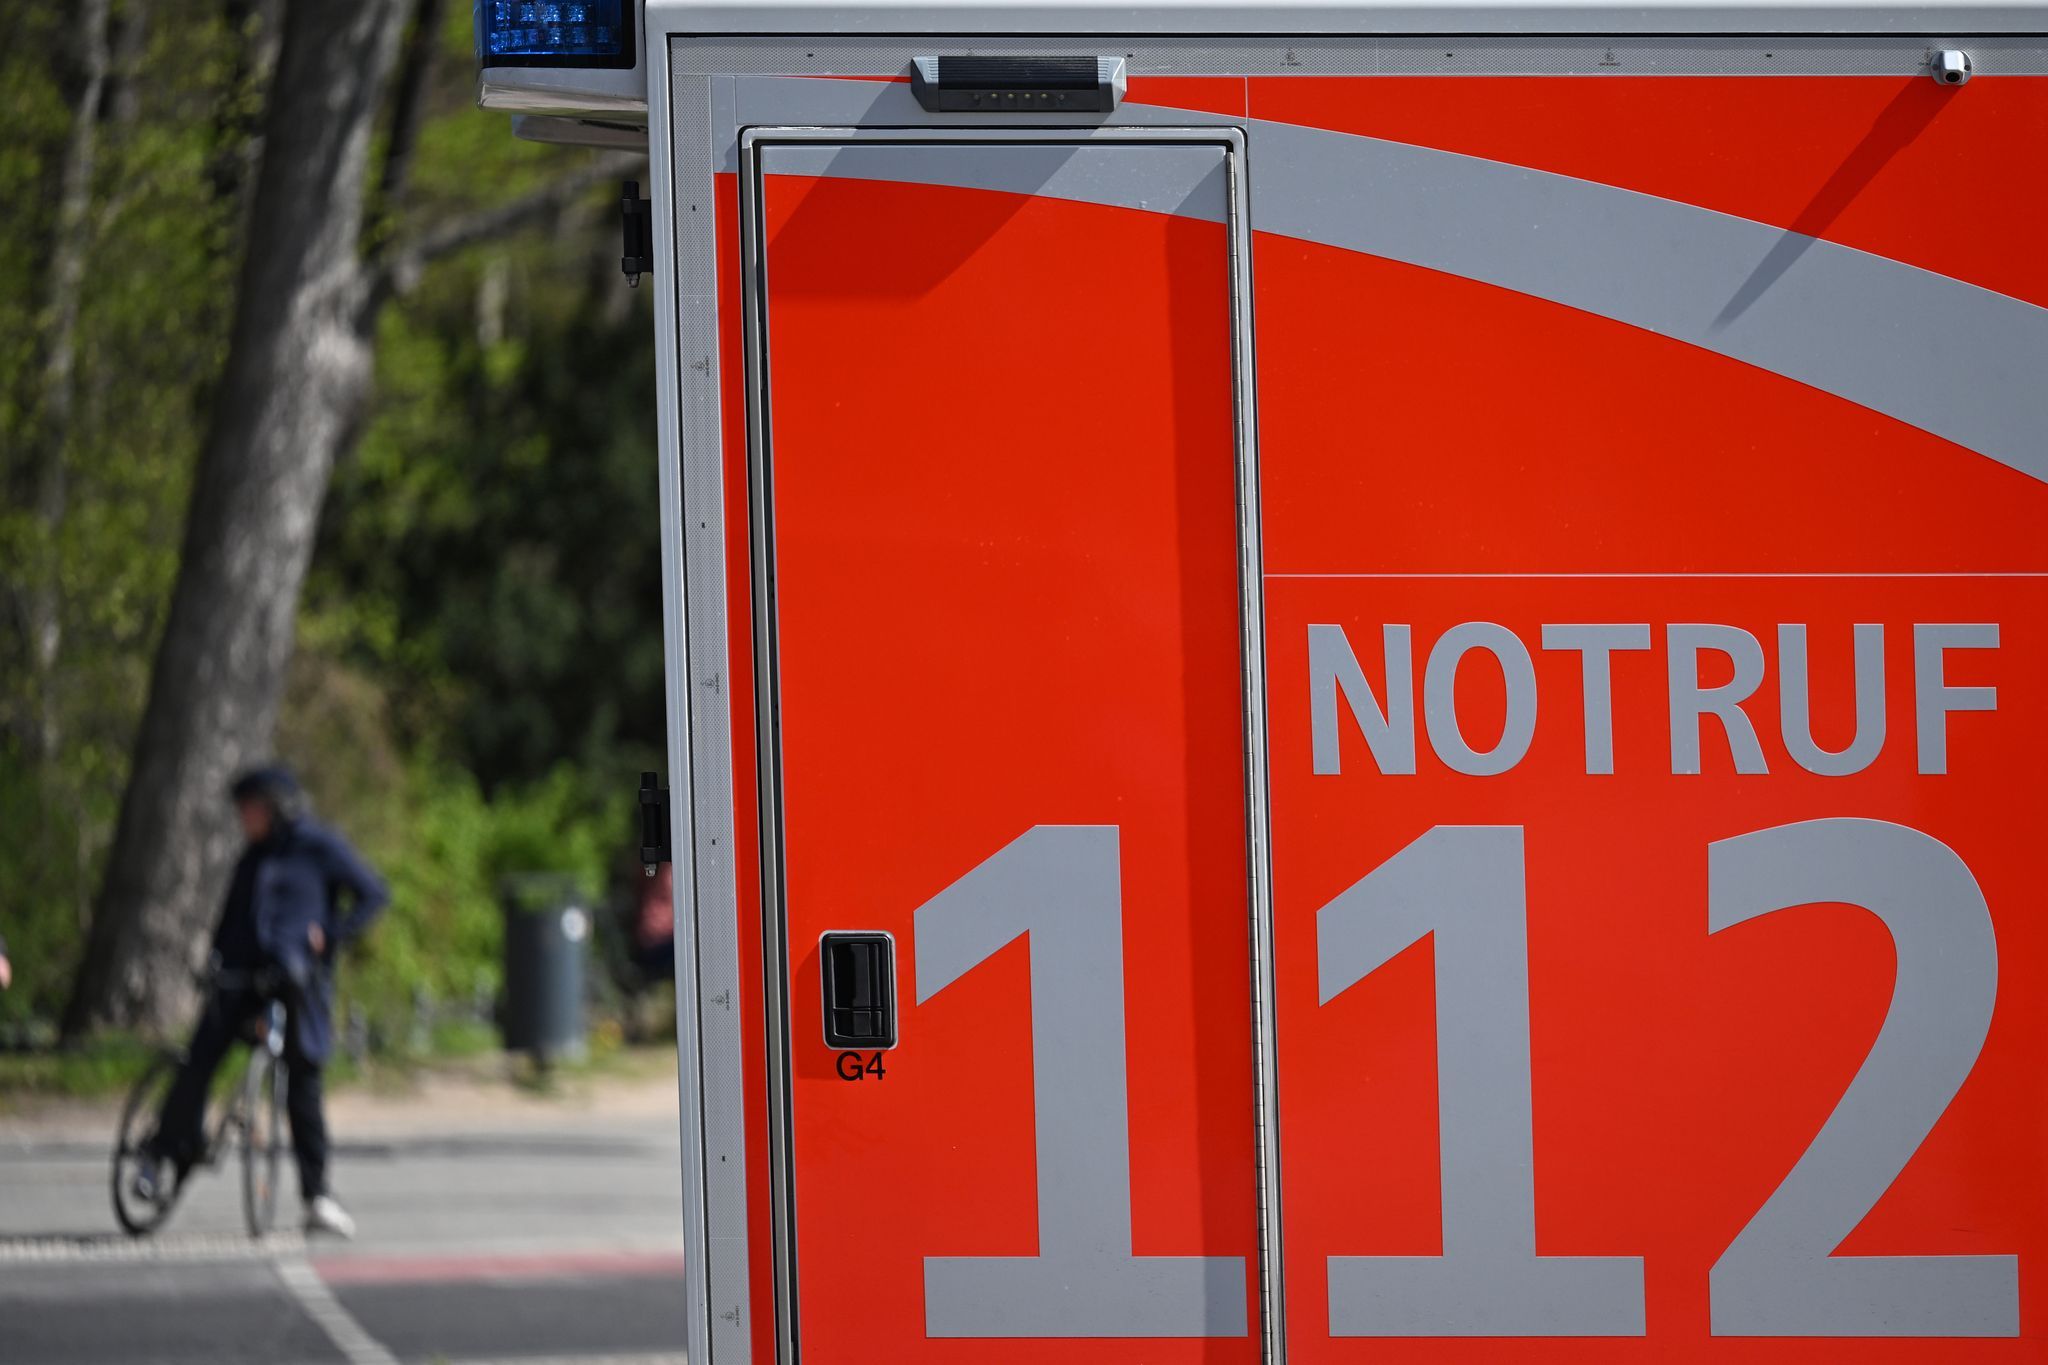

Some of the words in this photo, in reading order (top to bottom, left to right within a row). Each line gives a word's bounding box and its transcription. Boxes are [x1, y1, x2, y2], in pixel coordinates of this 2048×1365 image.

[1307, 622, 2000, 777] NOTRUF
[836, 1051, 886, 1081] G4
[914, 818, 2020, 1337] 112
